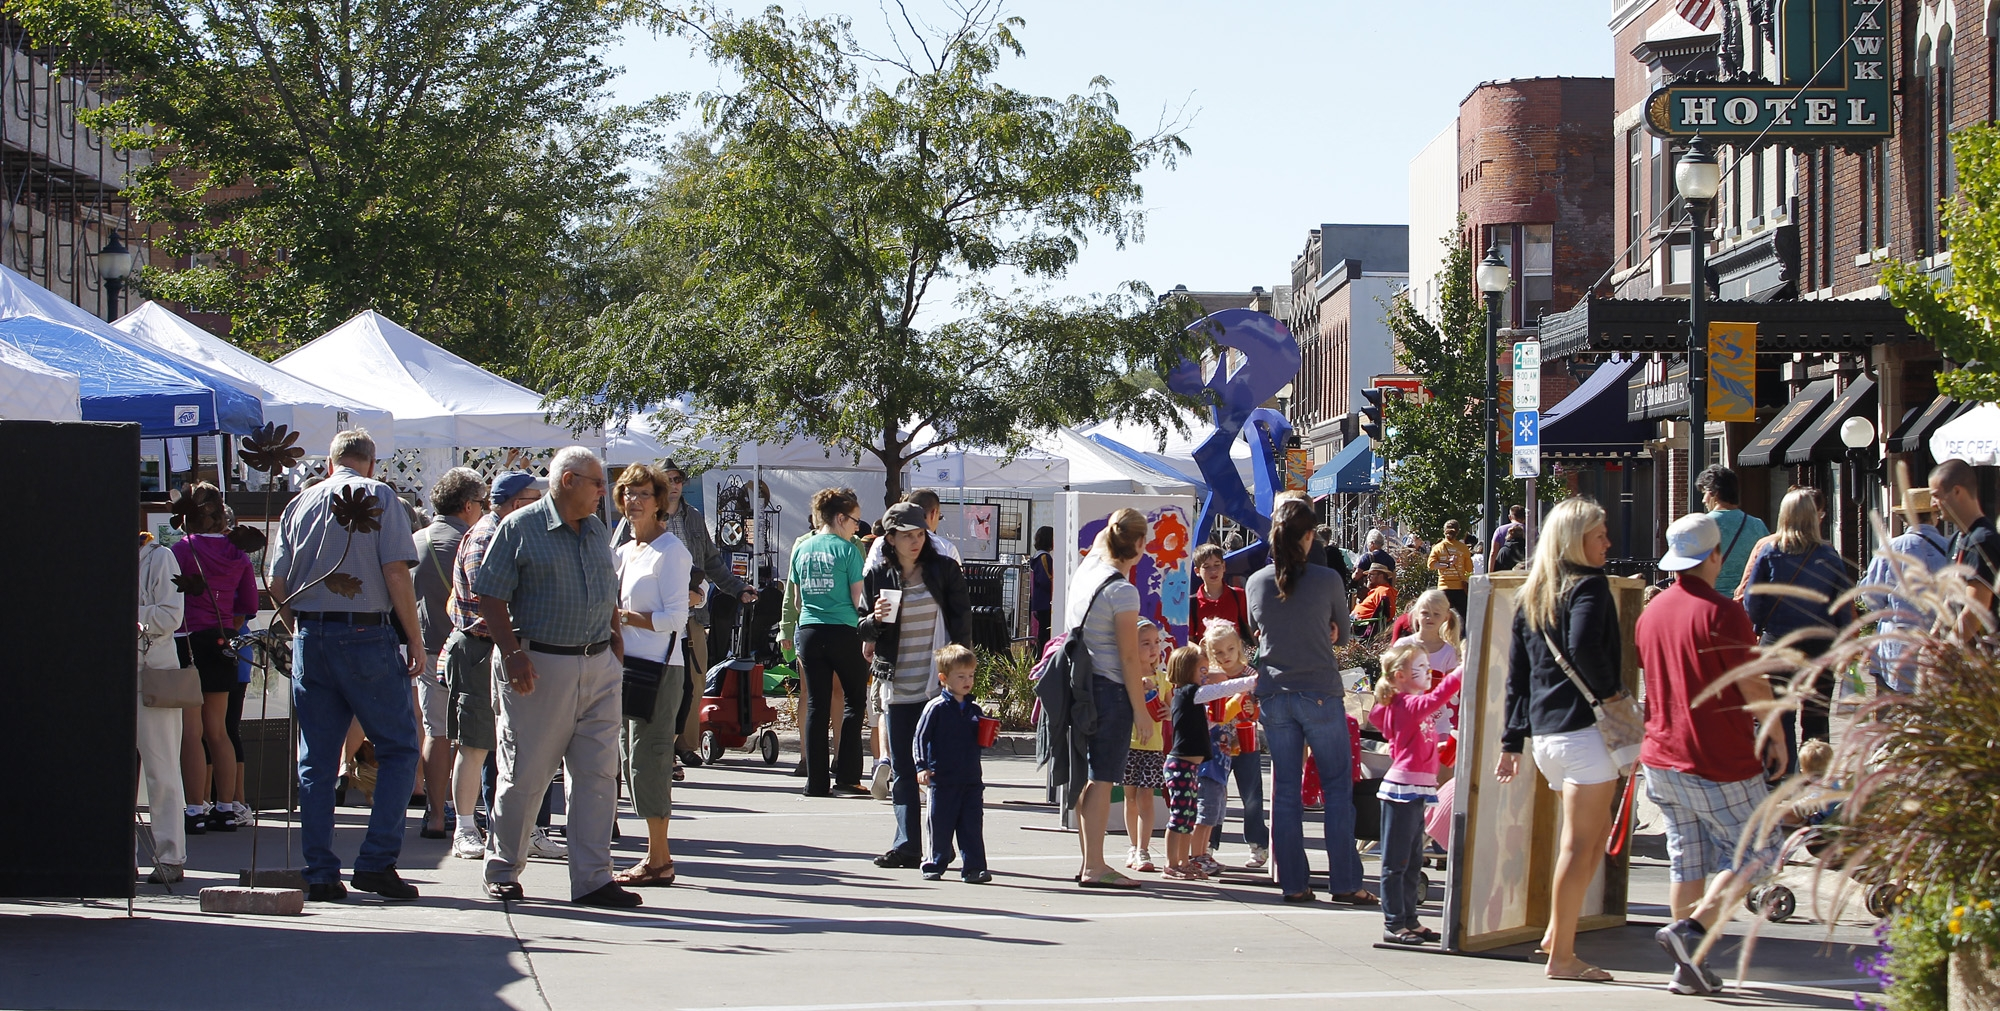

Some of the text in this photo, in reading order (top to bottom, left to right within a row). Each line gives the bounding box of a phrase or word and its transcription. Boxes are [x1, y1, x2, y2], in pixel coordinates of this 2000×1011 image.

[1851, 0, 1884, 79] AWK
[1680, 97, 1876, 125] HOTEL
[1515, 349, 1522, 365] 2
[1522, 357, 1538, 365] PARKING
[1517, 371, 1537, 380] 9:00 AM
[1523, 383, 1531, 392] TO
[1530, 395, 1537, 403] PM
